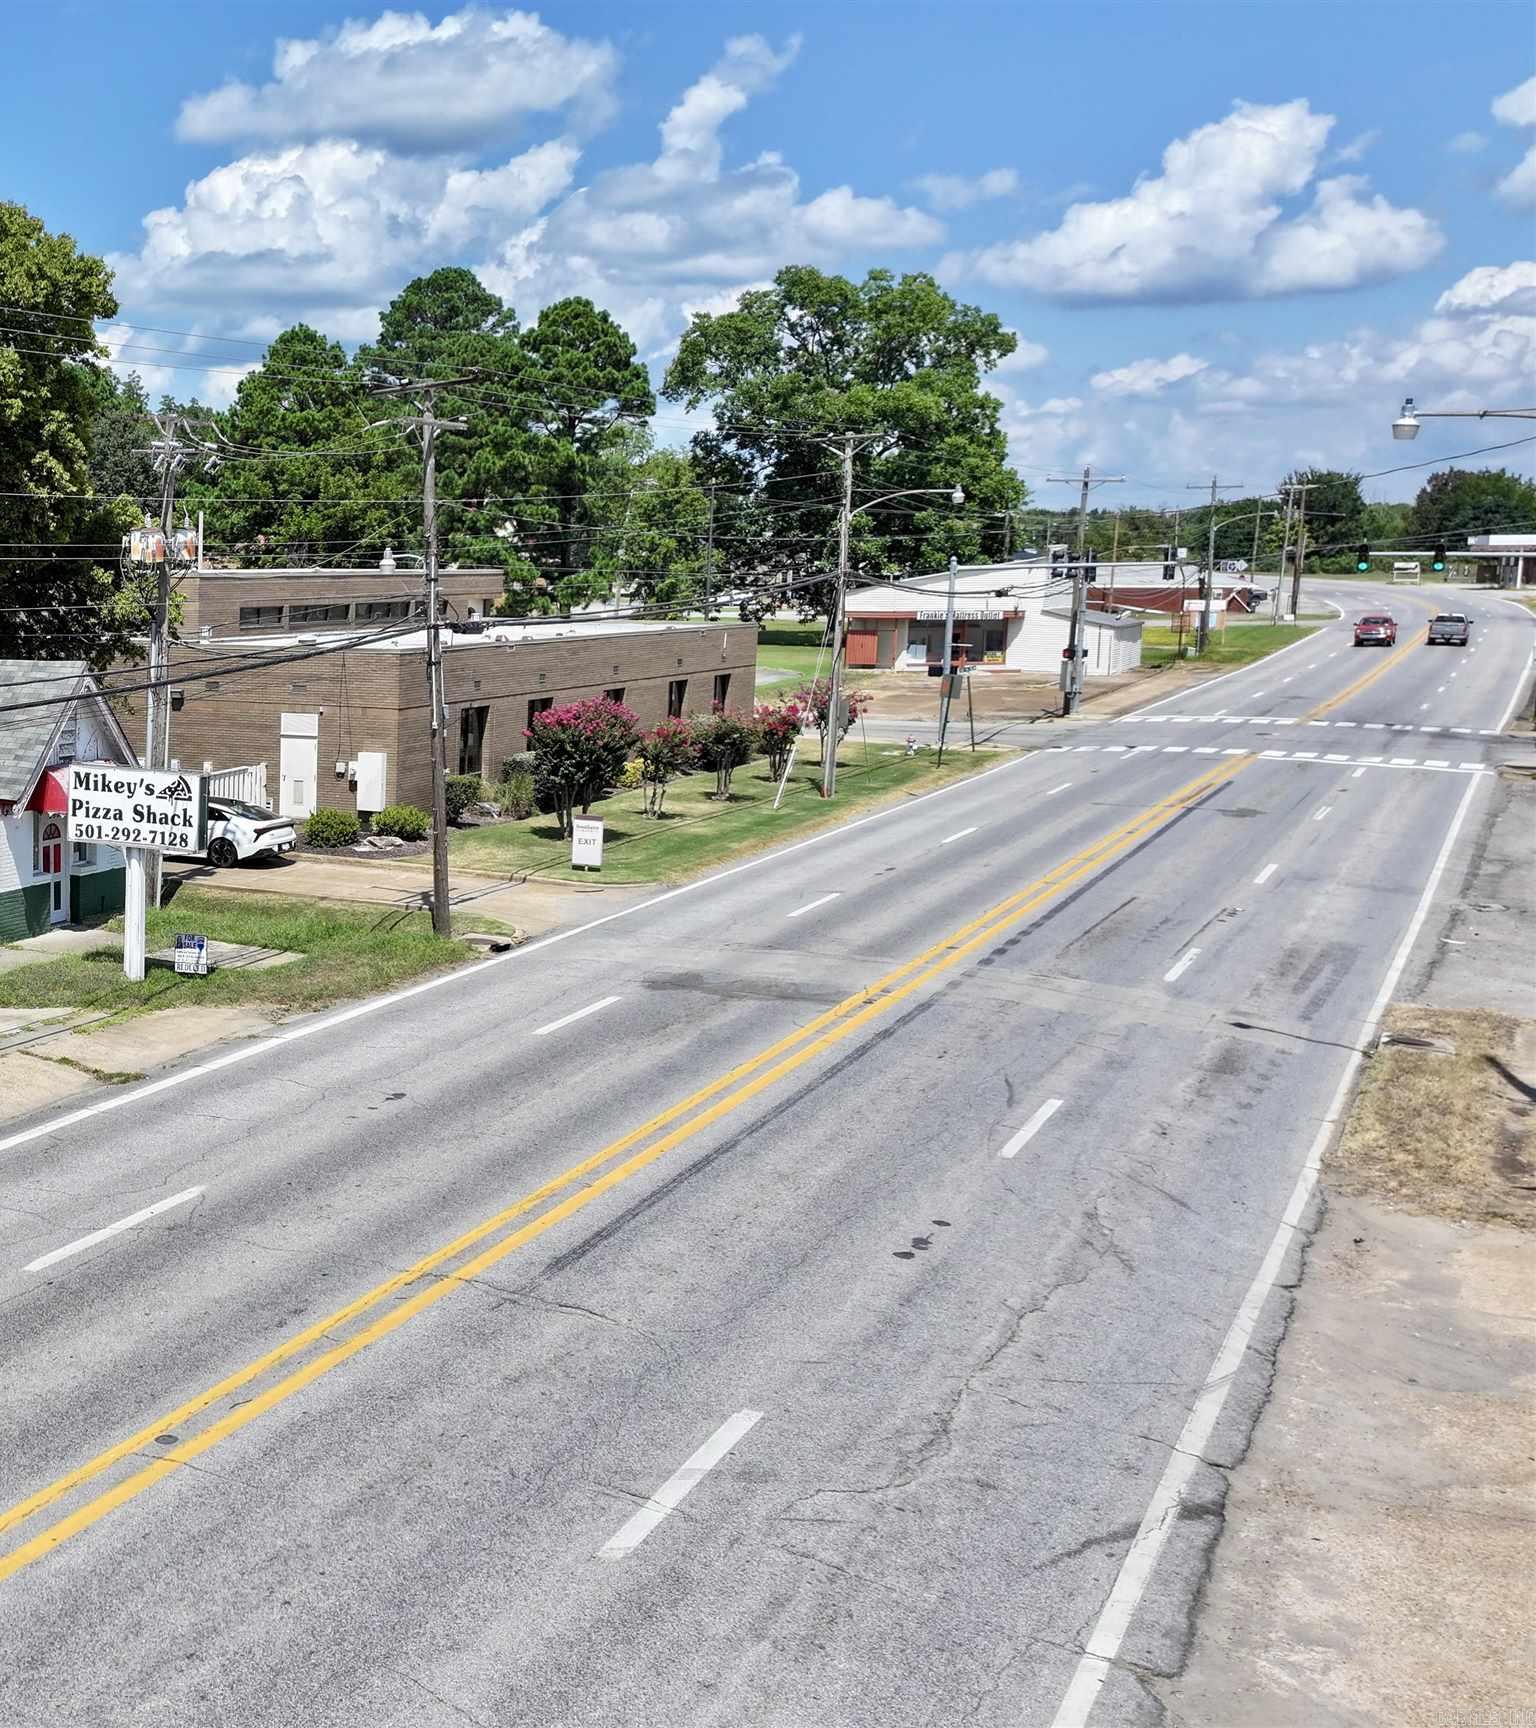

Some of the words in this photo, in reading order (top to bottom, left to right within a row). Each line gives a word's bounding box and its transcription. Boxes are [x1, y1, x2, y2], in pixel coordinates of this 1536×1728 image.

[73, 771, 155, 799] Mikey's
[71, 799, 123, 821] Pizza
[132, 804, 194, 828] Shack
[74, 824, 189, 848] 501-292-7128
[578, 837, 597, 845] EXIT
[183, 941, 197, 949] SALE
